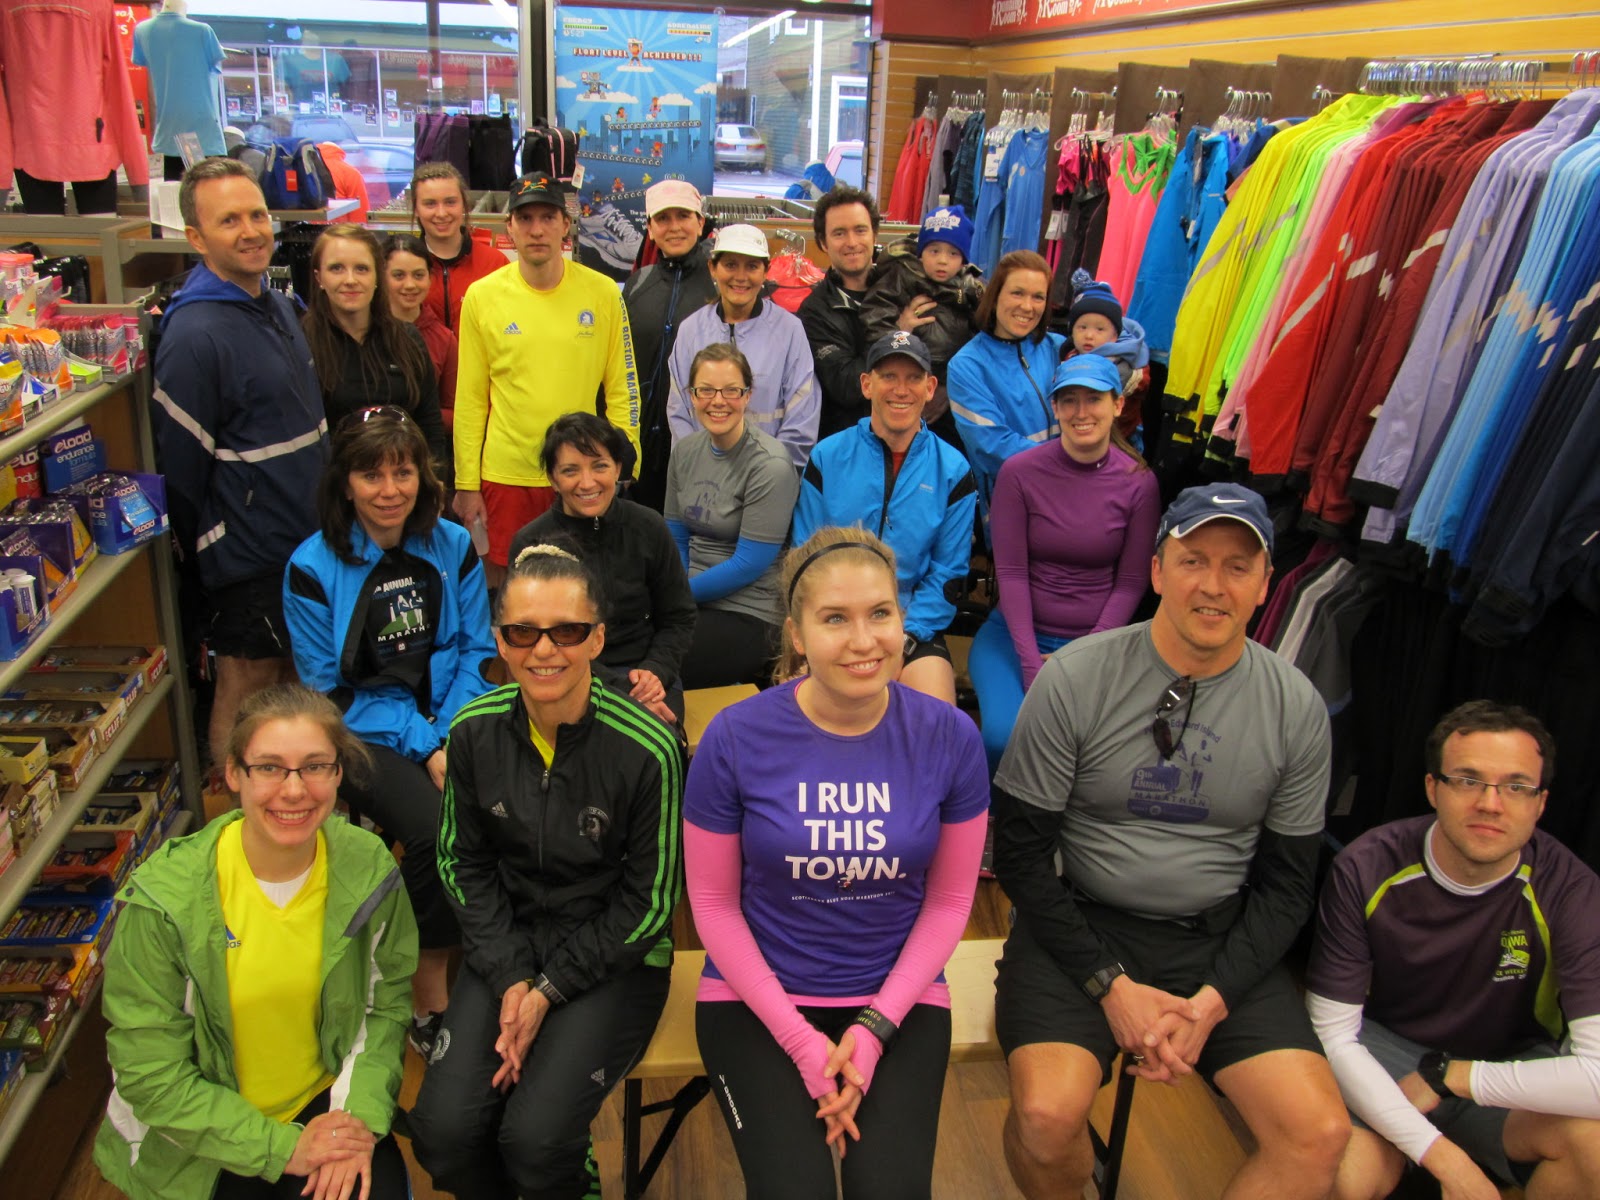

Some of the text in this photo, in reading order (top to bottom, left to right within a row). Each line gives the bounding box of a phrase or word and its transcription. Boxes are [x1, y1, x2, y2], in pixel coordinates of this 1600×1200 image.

[573, 48, 600, 57] FLOAT
[602, 49, 630, 59] LEVEL
[626, 371, 640, 427] MARATHON
[54, 430, 92, 454] eload
[56, 444, 95, 464] endurance
[133, 519, 155, 536] eload
[798, 782, 891, 814] I RUN
[1134, 792, 1205, 807] MARATHON
[803, 819, 887, 851] THIS
[723, 1086, 743, 1130] BROOKS
